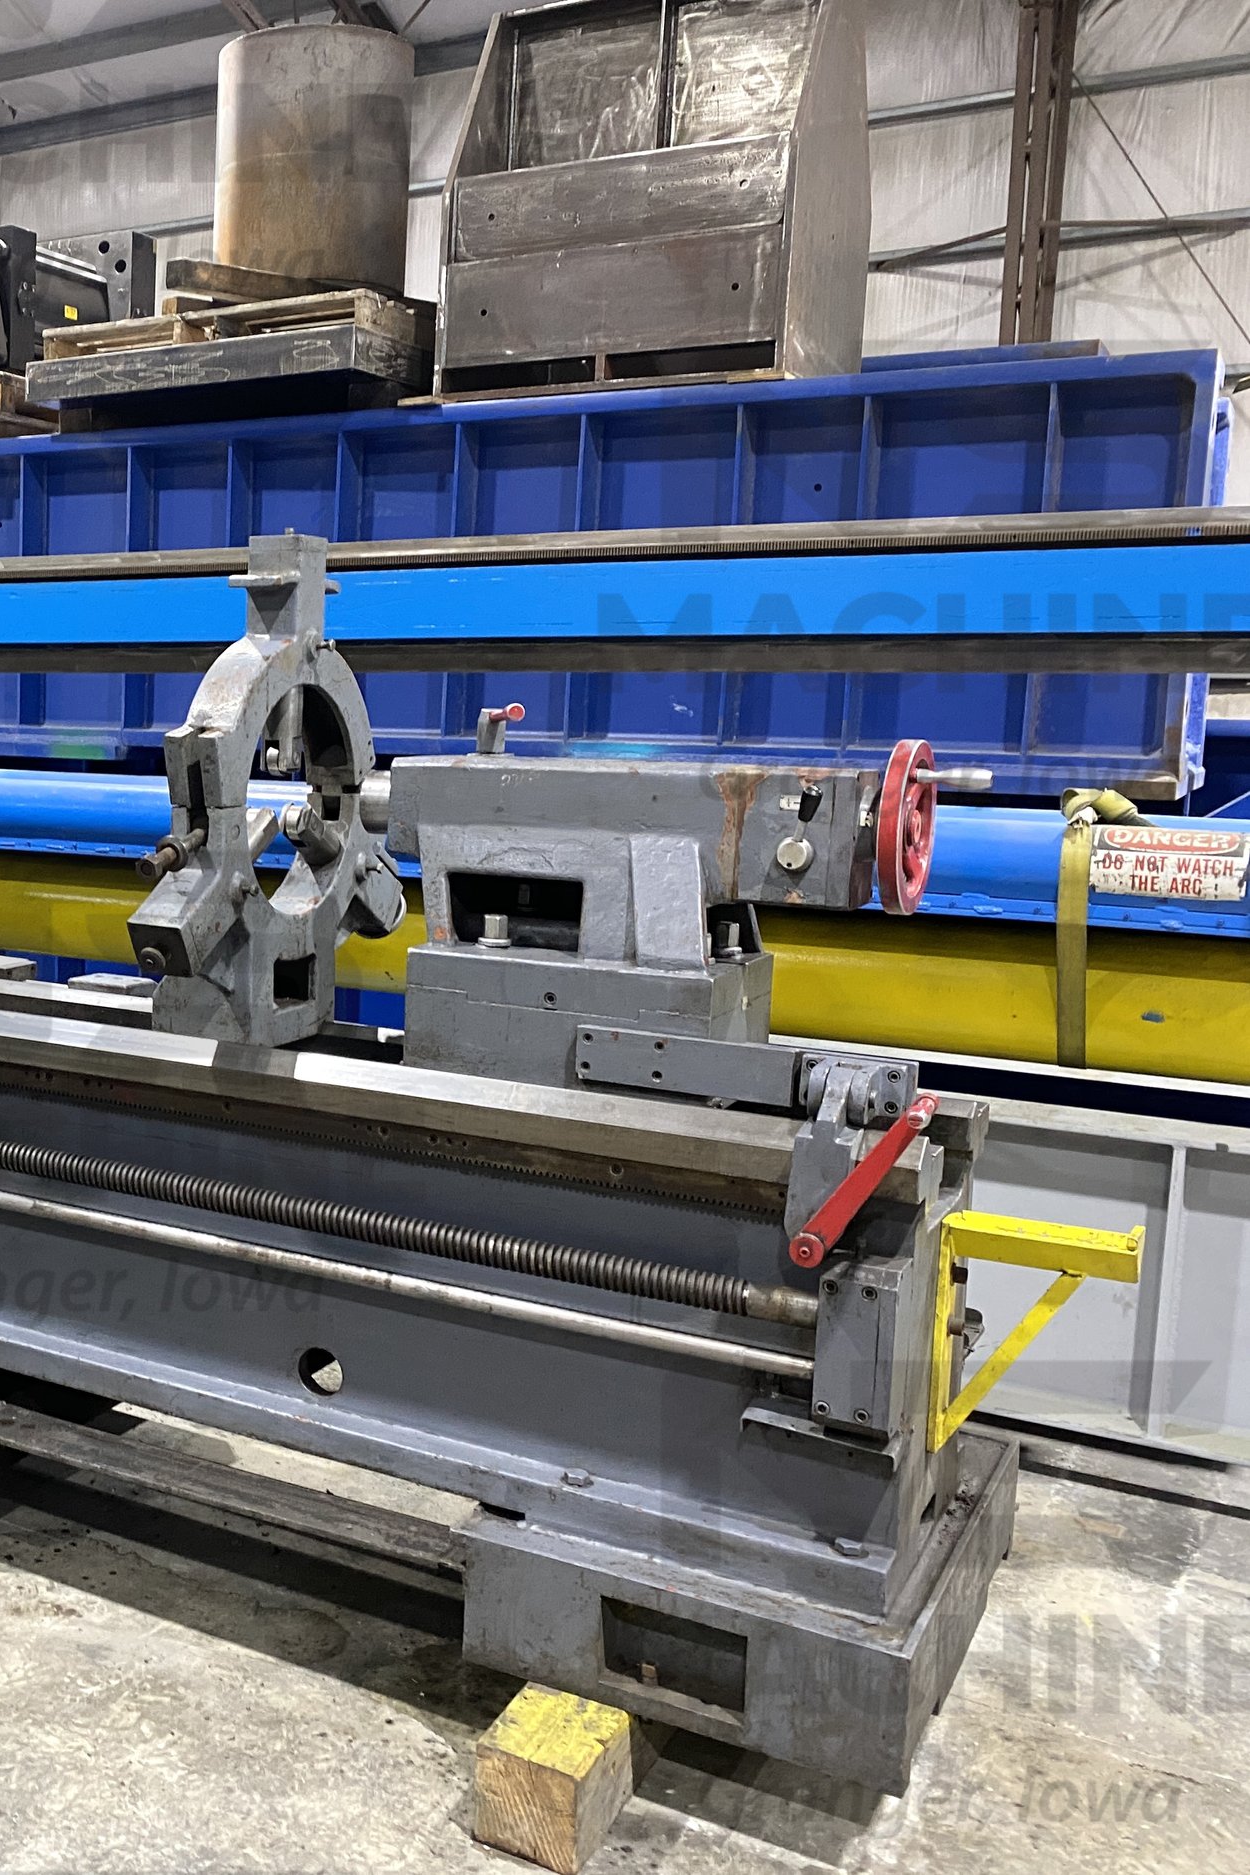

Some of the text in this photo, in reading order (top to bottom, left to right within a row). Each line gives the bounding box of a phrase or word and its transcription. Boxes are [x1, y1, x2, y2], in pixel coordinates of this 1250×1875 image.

[1113, 829, 1232, 849] DANGER
[1102, 853, 1235, 877] DO NOT WATCH
[1130, 874, 1203, 895] THE ARC
